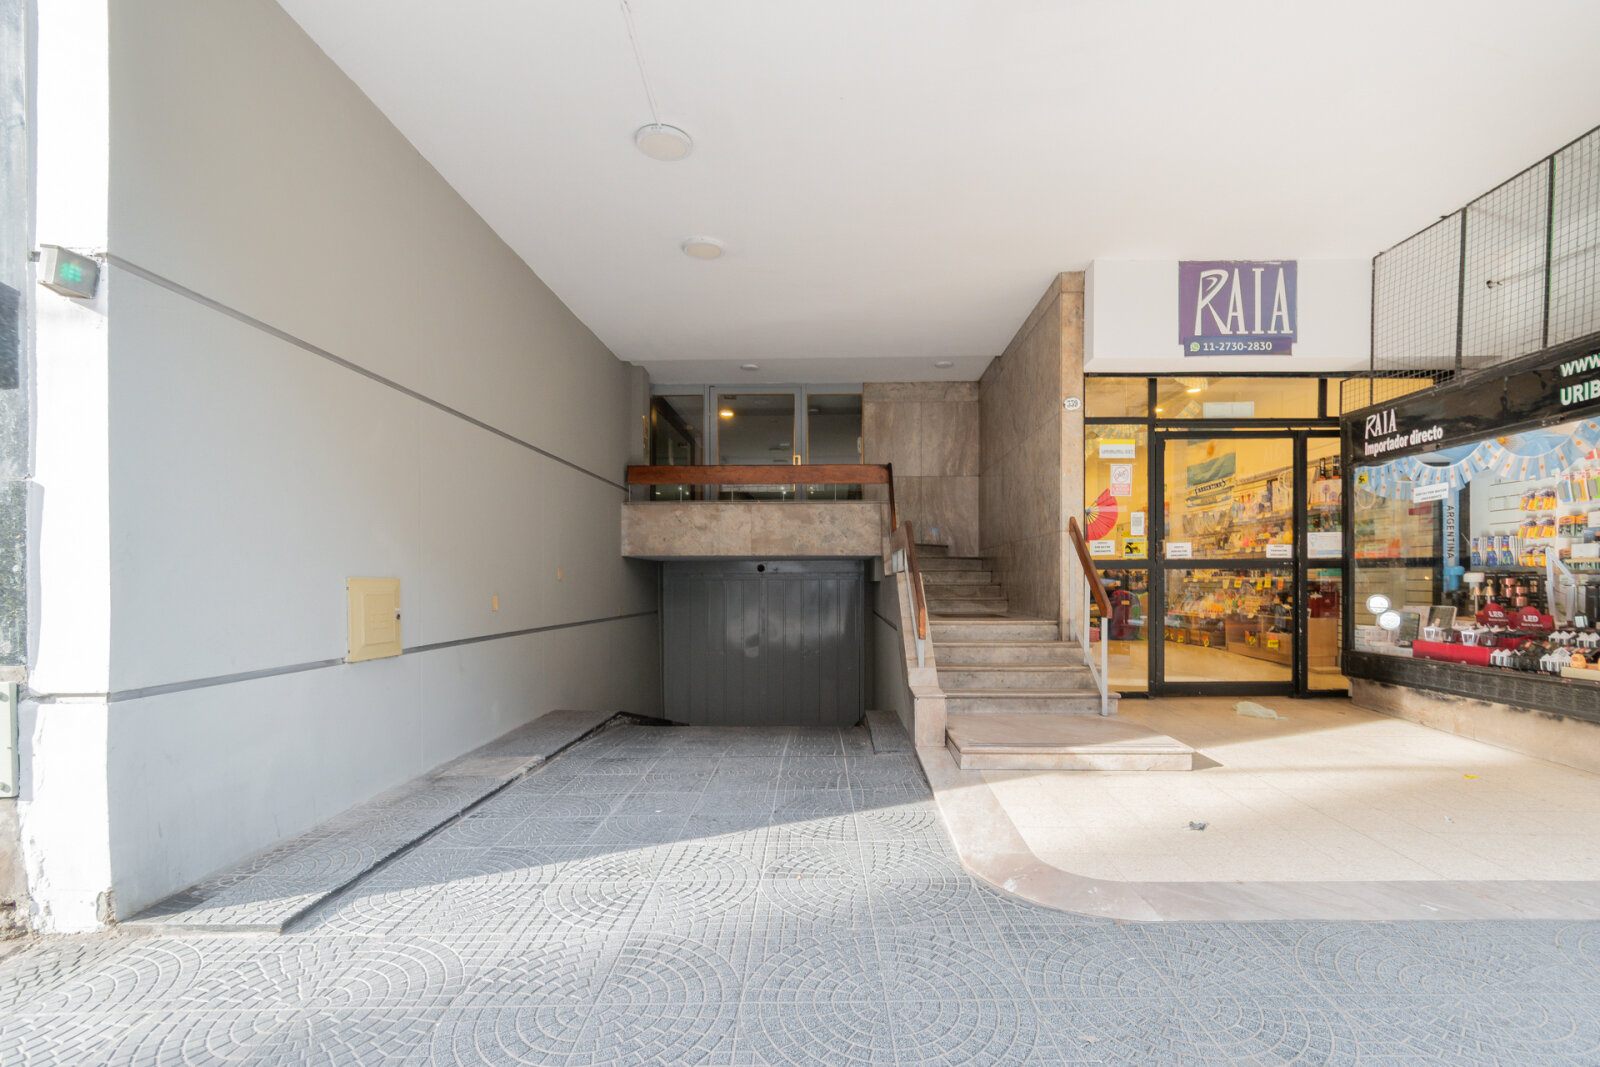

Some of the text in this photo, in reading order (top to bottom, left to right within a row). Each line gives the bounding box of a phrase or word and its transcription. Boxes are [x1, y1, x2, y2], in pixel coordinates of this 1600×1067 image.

[1194, 267, 1294, 336] RAIA
[1203, 341, 1273, 351] 11-2730-2830
[1364, 408, 1397, 440] RAIA
[1364, 425, 1444, 458] Importador directo
[1446, 504, 1457, 560] ARGENTINA
[1488, 610, 1504, 618] LED
[1522, 614, 1539, 623] LED
